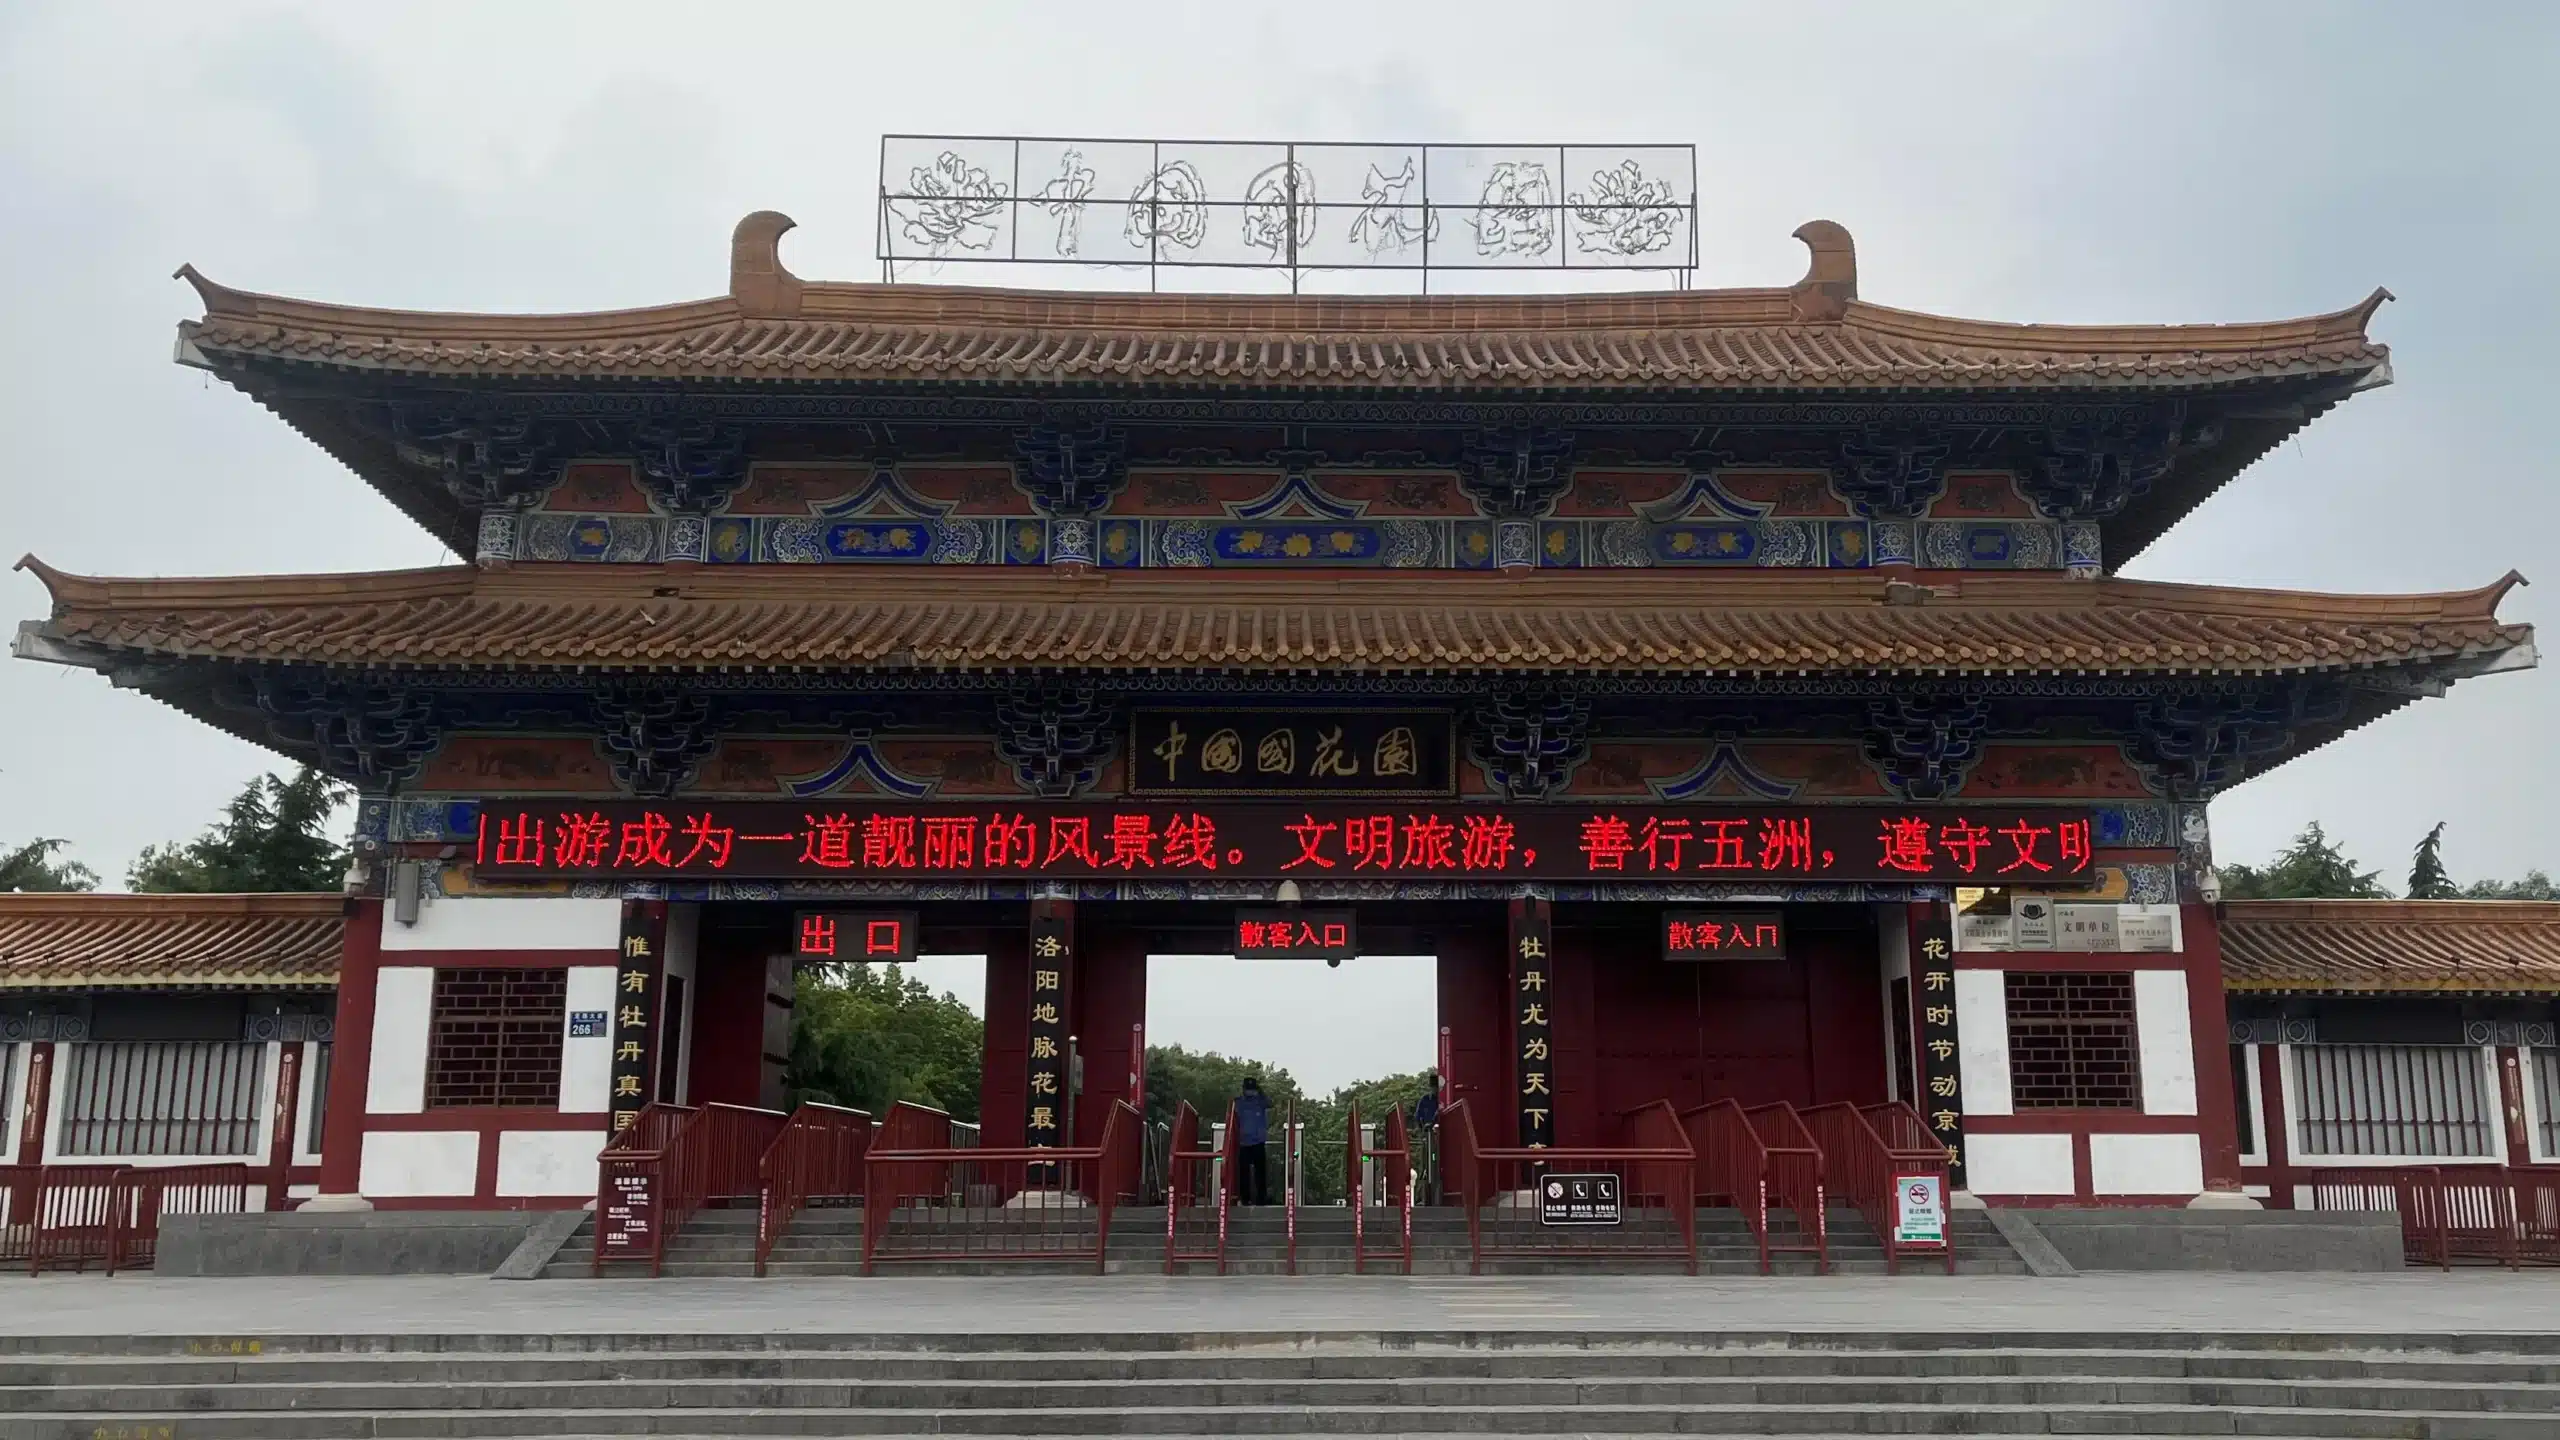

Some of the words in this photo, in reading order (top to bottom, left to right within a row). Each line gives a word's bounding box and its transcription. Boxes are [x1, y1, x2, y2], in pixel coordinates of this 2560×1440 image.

[800, 915, 900, 956] 出口
[1239, 921, 1346, 948] 散客入口
[572, 1024, 591, 1035] 266
[613, 935, 651, 1168] 惟有牡丹真国
[1028, 936, 1062, 1167] 洛阳地脉花最
[1519, 936, 1550, 1166] 牡丹尤为天下
